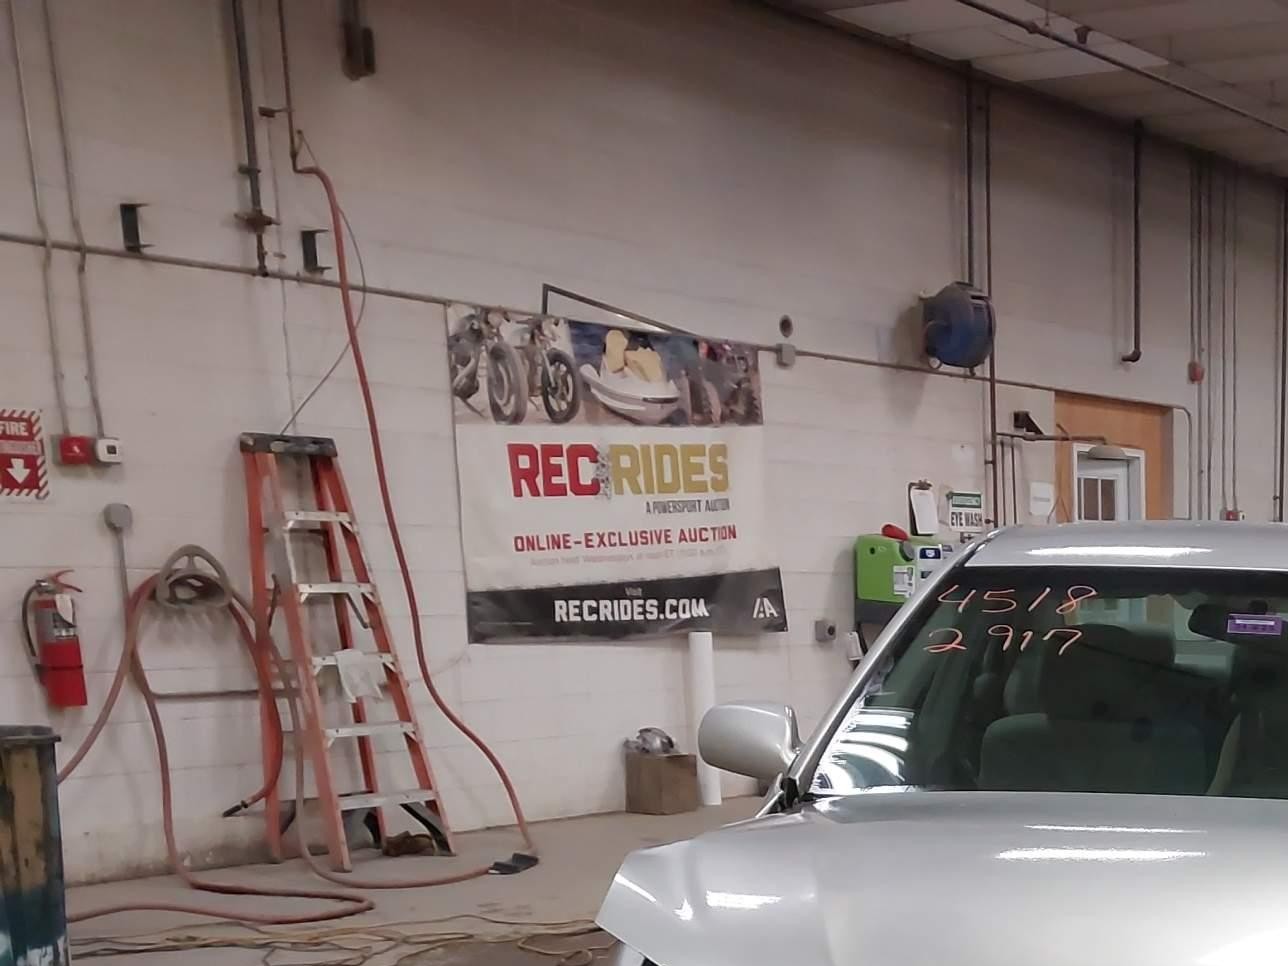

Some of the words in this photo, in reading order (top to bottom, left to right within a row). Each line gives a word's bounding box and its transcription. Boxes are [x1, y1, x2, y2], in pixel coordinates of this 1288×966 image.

[951, 512, 963, 527] EYE
[964, 512, 983, 527] WASH
[514, 528, 672, 552] ONLINE-EXCLUSIVE
[678, 525, 737, 543] AUCTION
[554, 598, 710, 622] RECRIDES.COM
[938, 585, 1098, 613] 4518
